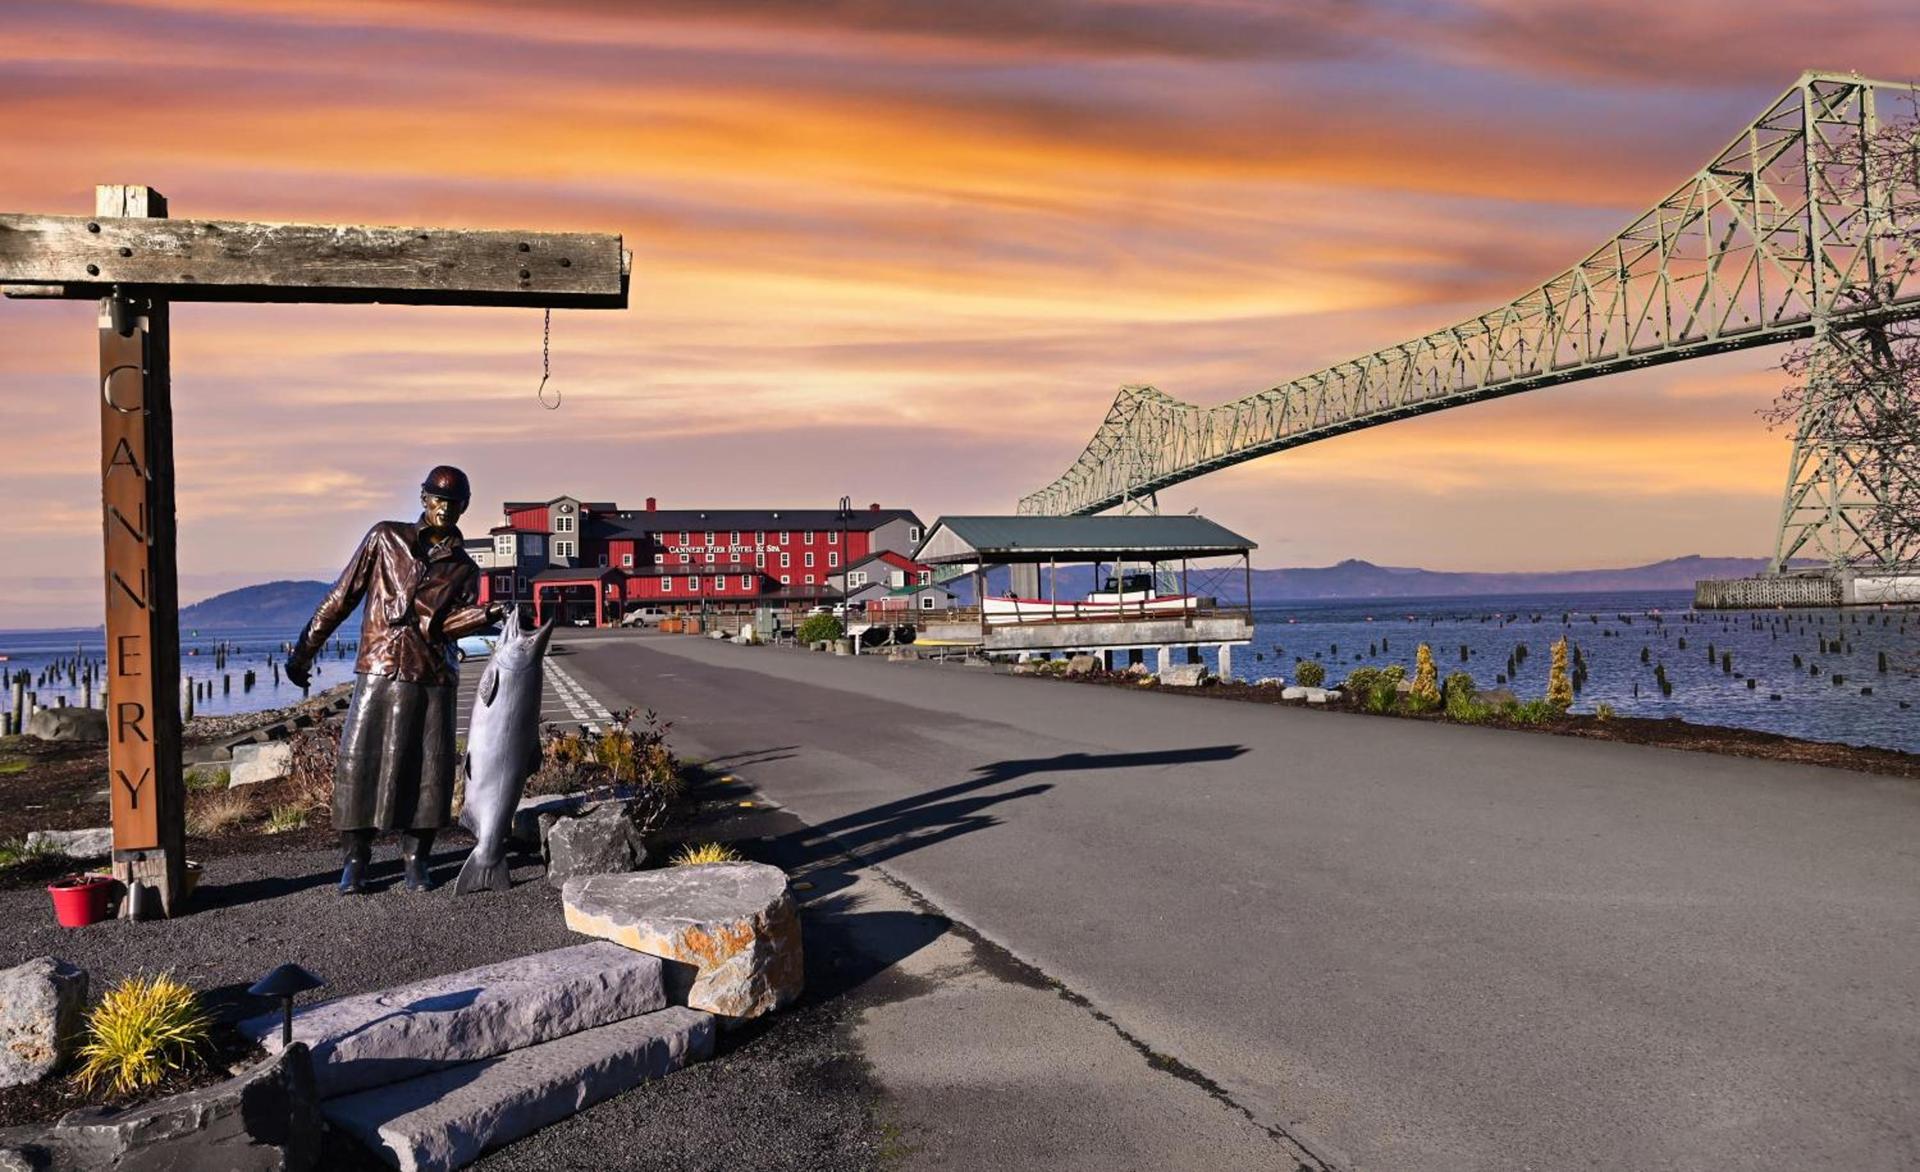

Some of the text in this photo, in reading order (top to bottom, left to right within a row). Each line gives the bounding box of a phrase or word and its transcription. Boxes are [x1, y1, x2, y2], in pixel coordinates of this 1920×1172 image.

[104, 365, 149, 810] CANNERY
[728, 545, 753, 553] HOTEL
[766, 544, 780, 552] SPA
